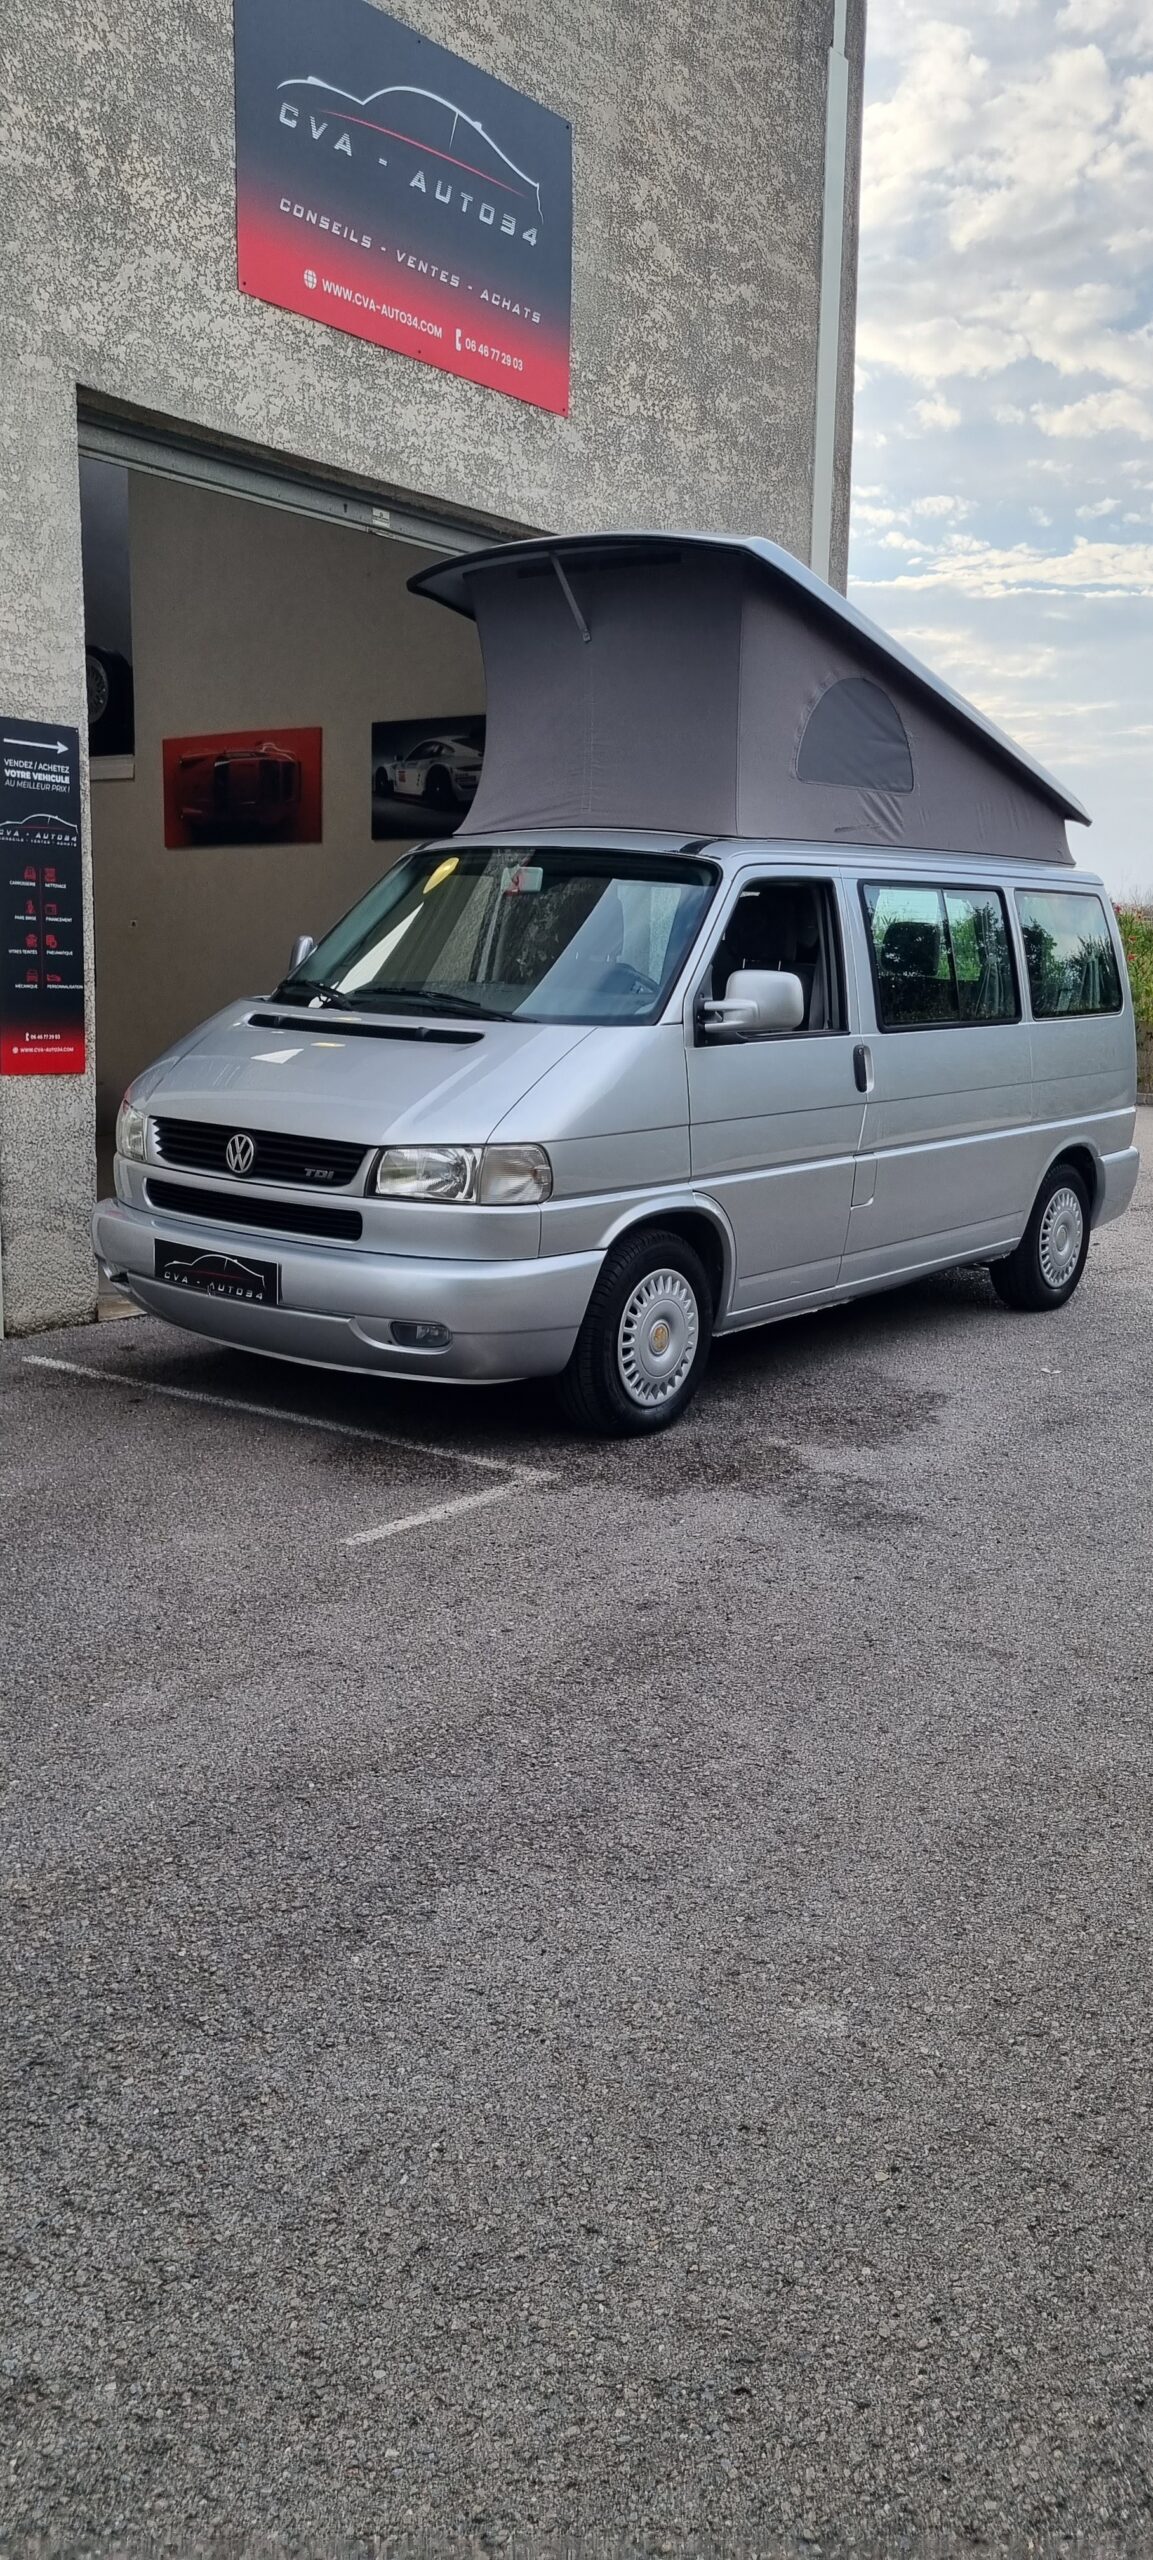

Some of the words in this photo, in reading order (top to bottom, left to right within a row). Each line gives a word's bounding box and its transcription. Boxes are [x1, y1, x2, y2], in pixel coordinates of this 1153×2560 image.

[279, 102, 353, 157] CVA
[409, 170, 538, 246] AUTO34
[279, 198, 373, 249] CONSEILS
[396, 249, 461, 288] VENTES
[480, 289, 542, 324] ACHATS
[321, 278, 443, 339] WWW.CVA-AUTO34.COM
[465, 337, 477, 353] 06
[490, 344, 500, 361] 77
[513, 354, 524, 372] 03
[4, 758, 33, 770] VENDEZ
[38, 763, 70, 774] ACHETEZ
[4, 769, 31, 780] VOTRE
[32, 772, 70, 784] VEHICULE
[4, 779, 15, 787] AU
[16, 780, 50, 791] MEILLEUR
[51, 784, 66, 792] PRIX
[304, 1168, 334, 1180] TDI
[164, 1271, 188, 1284] CVA
[208, 1281, 263, 1300] AUTO34
